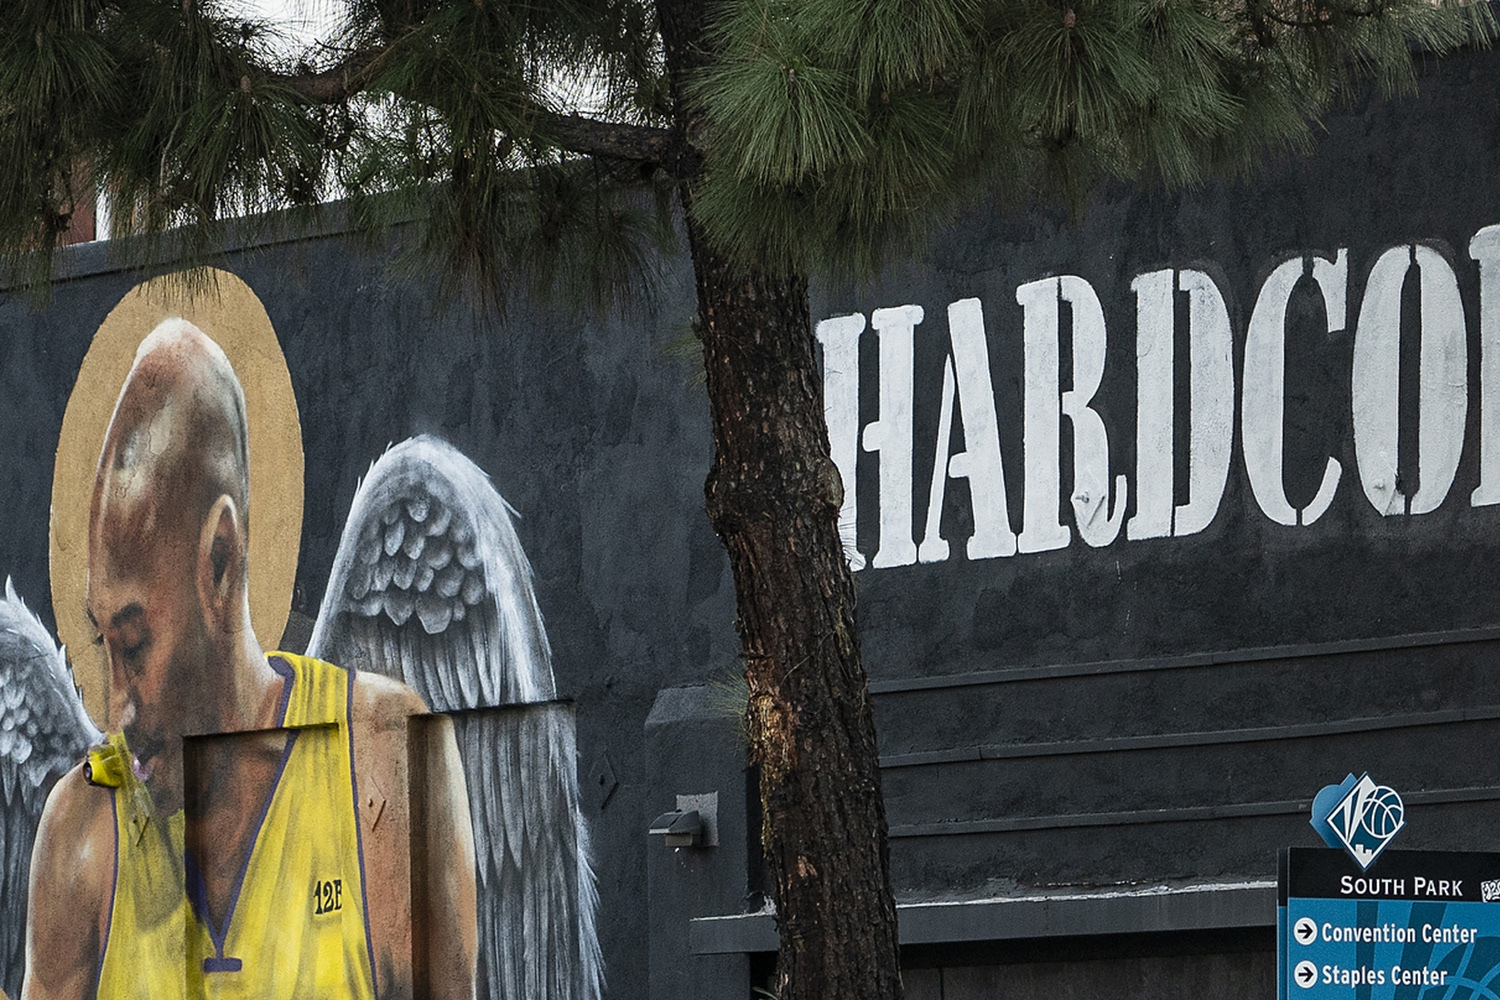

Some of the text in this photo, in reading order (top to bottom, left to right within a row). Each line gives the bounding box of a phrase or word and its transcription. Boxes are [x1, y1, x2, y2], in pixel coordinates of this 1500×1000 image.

[1340, 875, 1463, 896] SOUTH PARK
[1322, 922, 1478, 943] Convention Center
[1322, 965, 1447, 988] Staples Center
